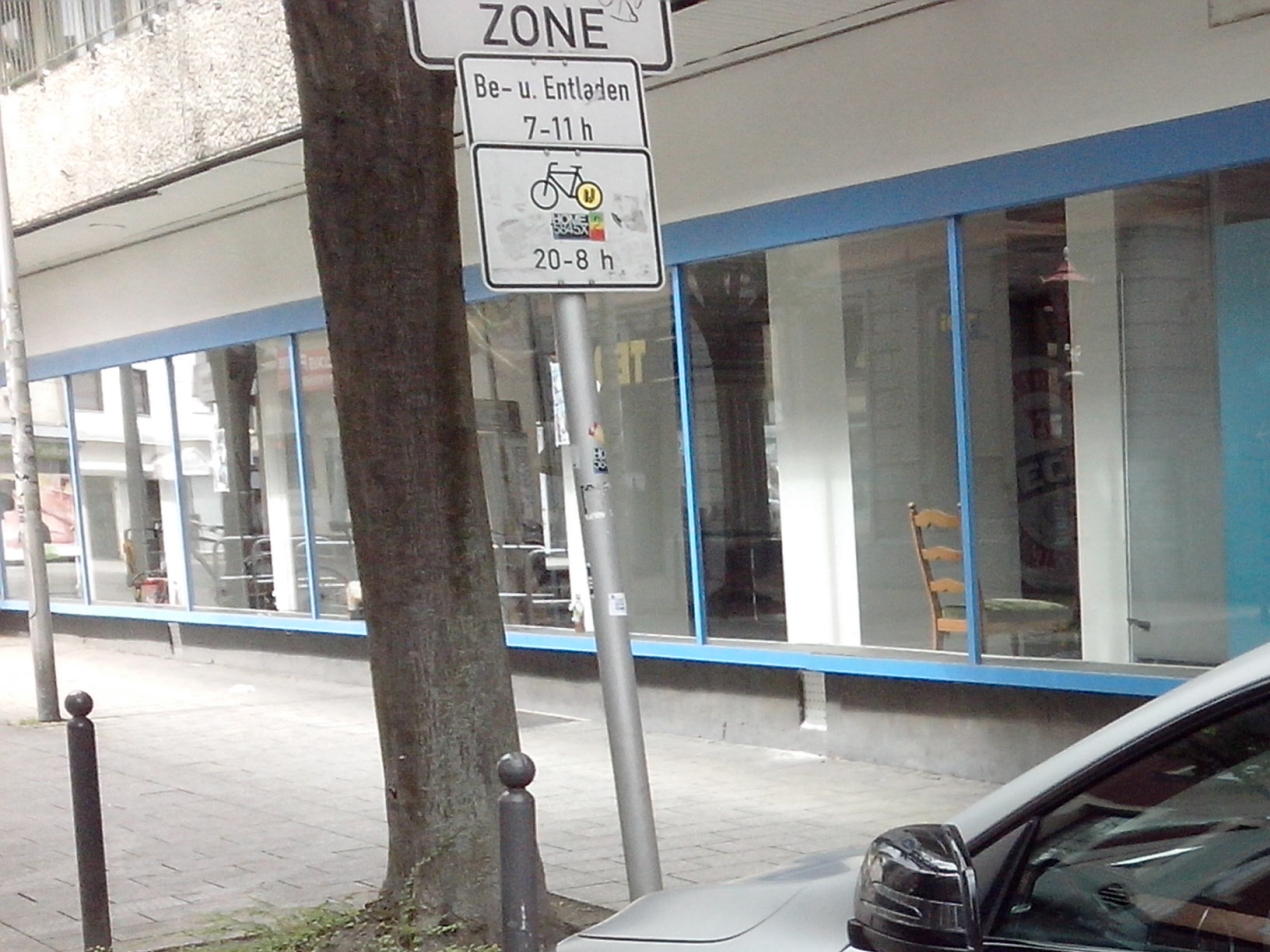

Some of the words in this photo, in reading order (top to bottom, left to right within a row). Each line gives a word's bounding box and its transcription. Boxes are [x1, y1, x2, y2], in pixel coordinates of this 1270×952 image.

[479, 3, 609, 50] ZONE
[474, 73, 513, 99] Be-
[519, 80, 537, 100] u.
[543, 75, 630, 102] Entladen
[523, 115, 573, 141] 7-11
[580, 116, 594, 142] h
[534, 248, 589, 270] 20-8
[601, 249, 614, 270] h
